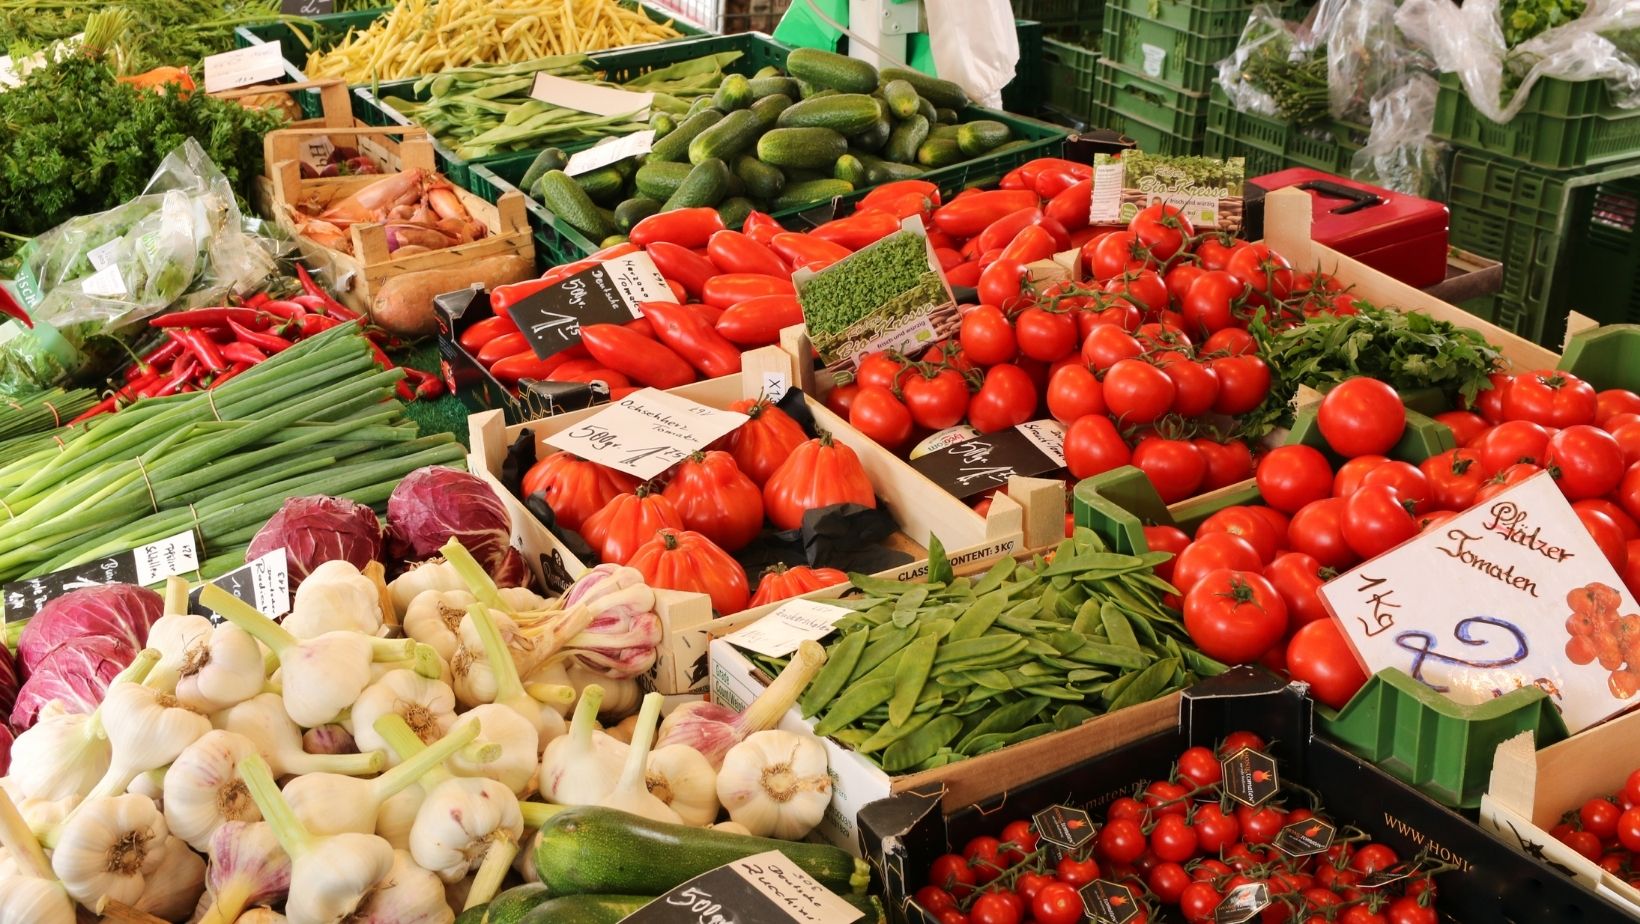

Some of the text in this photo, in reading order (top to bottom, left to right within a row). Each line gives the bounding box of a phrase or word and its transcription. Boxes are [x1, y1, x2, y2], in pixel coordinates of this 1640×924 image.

[1139, 175, 1228, 198] Bio-Kresse
[592, 269, 620, 310] Deutsche
[836, 302, 936, 360] Bio-Kresse
[877, 337, 893, 349] frisch
[893, 331, 906, 341] und
[898, 565, 929, 582] CLASS
[947, 546, 993, 567] ONTENT:
[994, 545, 1000, 554] 3
[1436, 529, 1539, 598] Tomaten
[1357, 573, 1387, 592] 1
[715, 664, 730, 686] Grade
[767, 864, 822, 908] Deutsche
